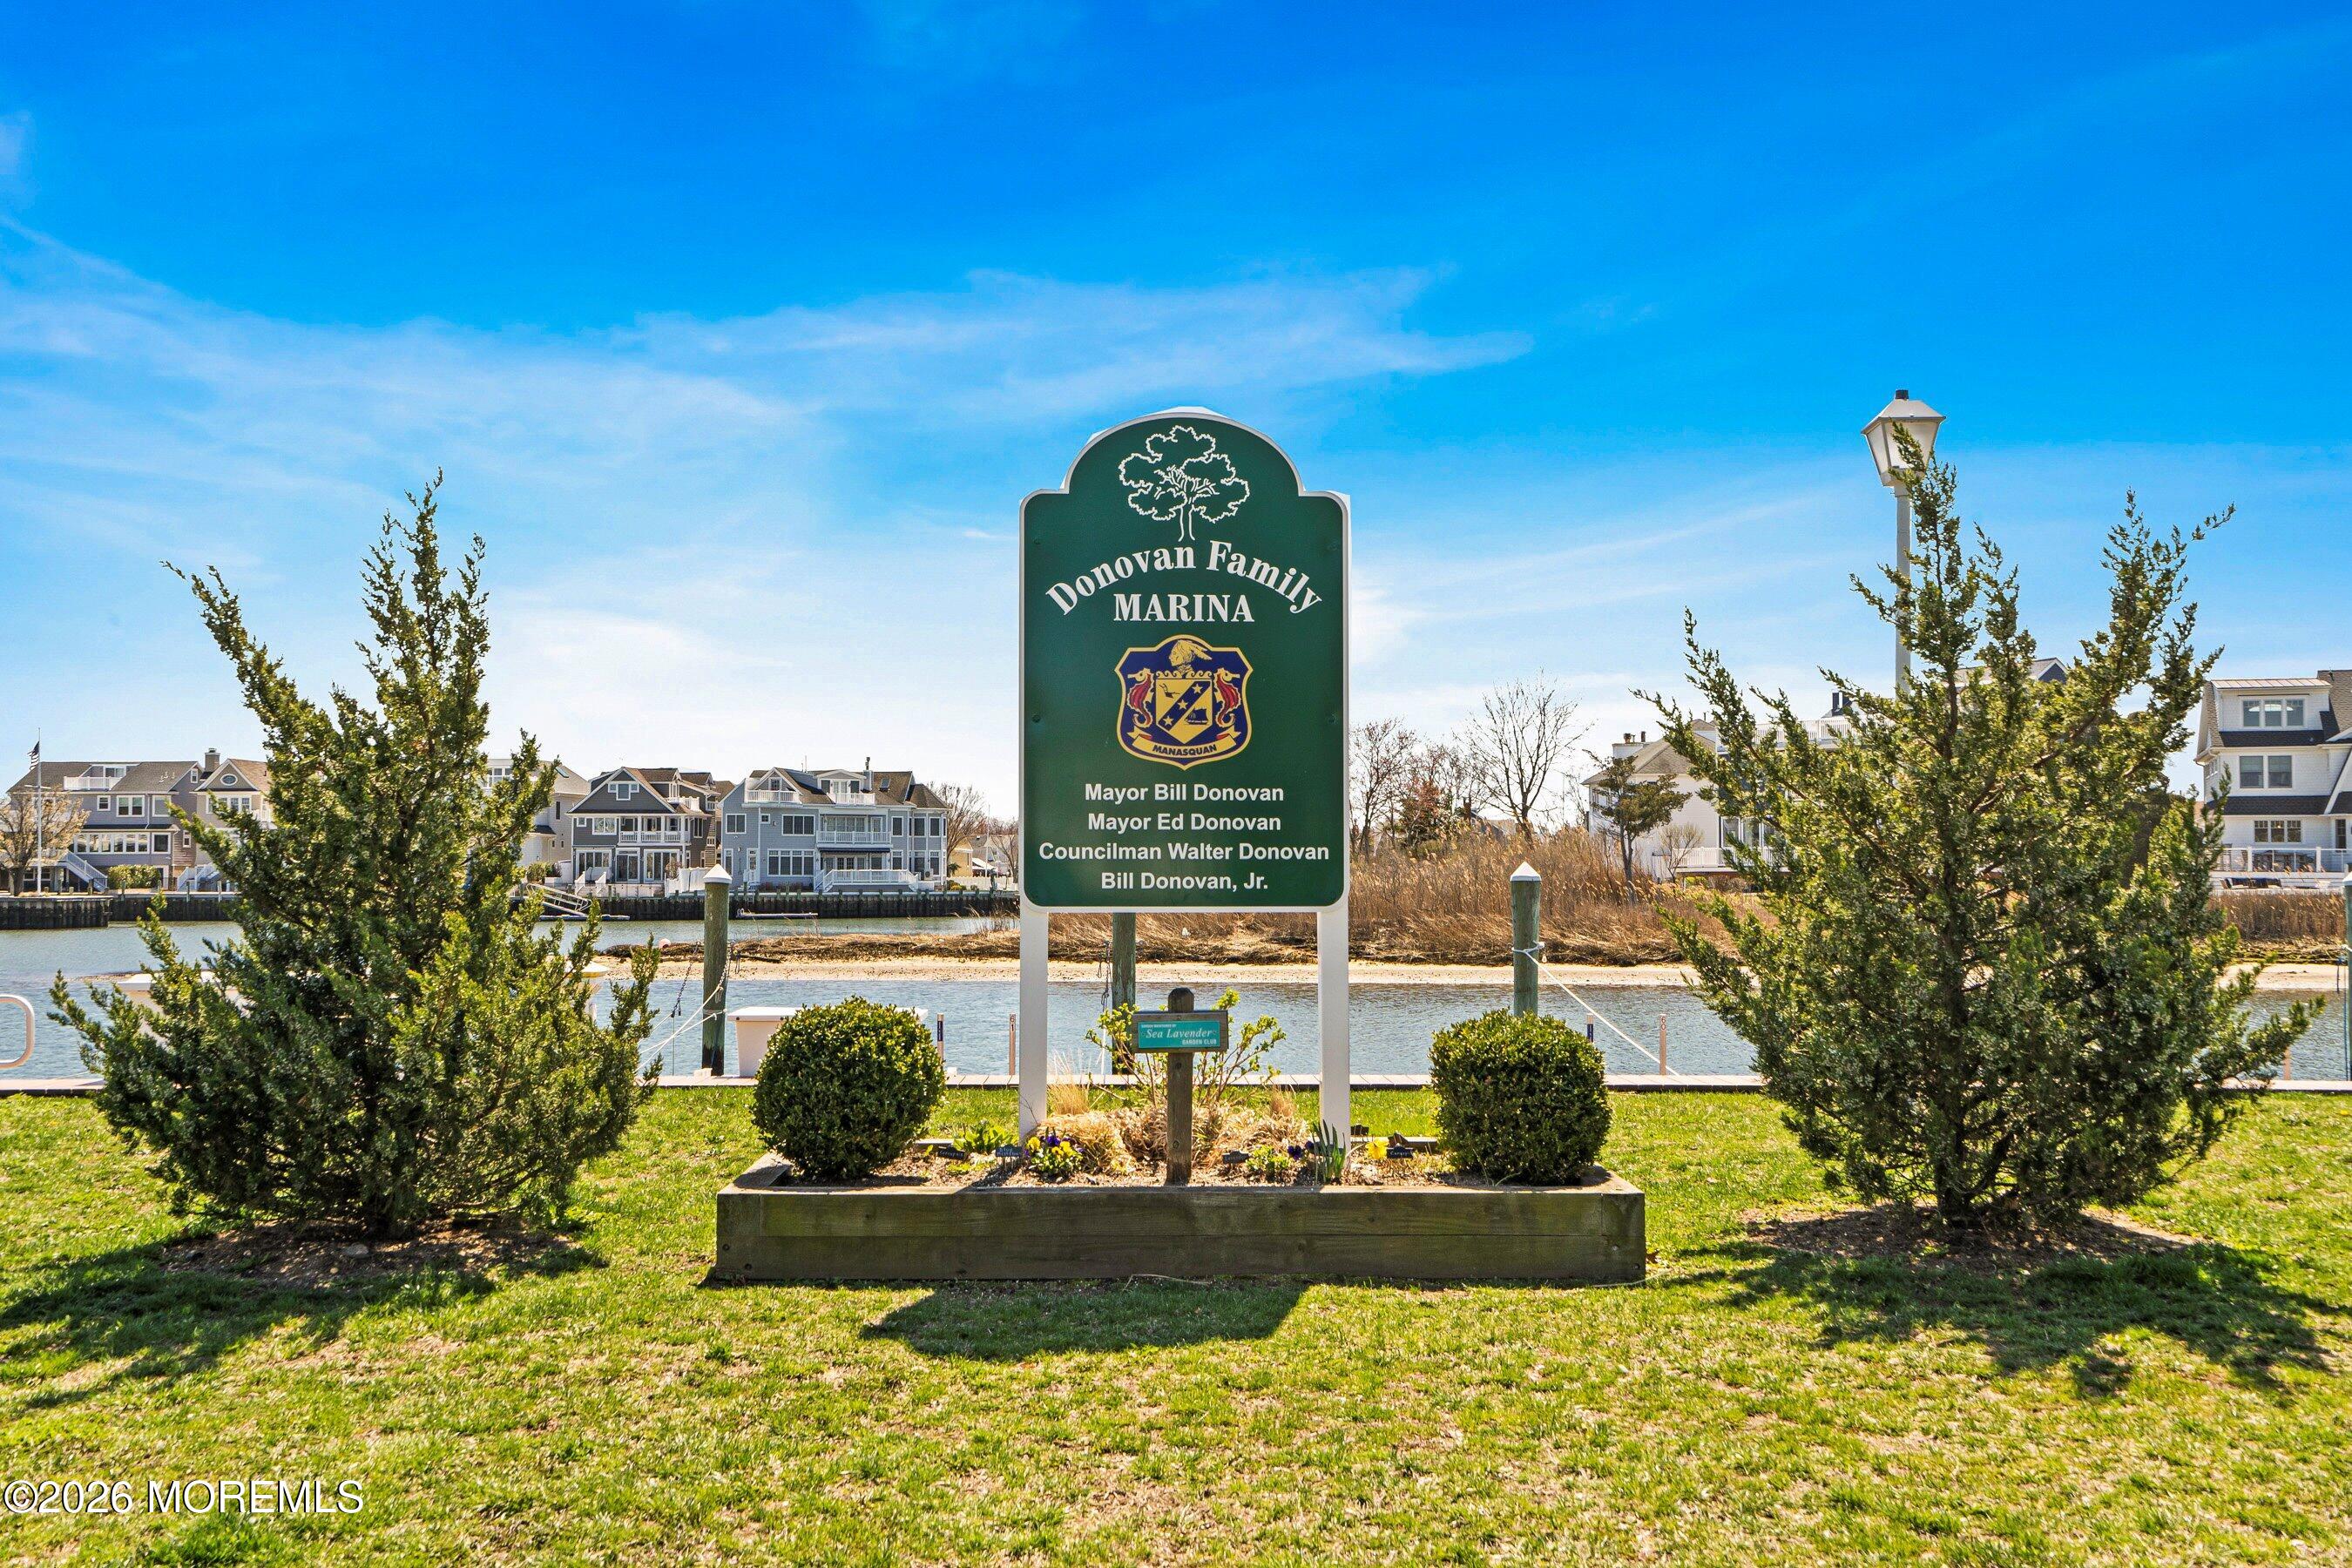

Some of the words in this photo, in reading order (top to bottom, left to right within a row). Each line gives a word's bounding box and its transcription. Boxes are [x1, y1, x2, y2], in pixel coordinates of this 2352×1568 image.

[1044, 546, 1196, 615] Donovan
[1206, 539, 1322, 614] Family
[1113, 593, 1254, 622] MARINA
[1152, 744, 1218, 756] MANASQUAN
[1085, 783, 1148, 805] Mayor
[1154, 783, 1187, 801] Bill
[1193, 783, 1284, 801] Donovan
[1088, 813, 1150, 835] Mayor
[1157, 813, 1184, 831] Ed
[1191, 813, 1281, 831] Donovan
[1038, 841, 1162, 861] Councilman
[1167, 842, 1233, 861] Walter
[1239, 842, 1329, 861] Donovan
[1101, 872, 1134, 889] Bill
[1140, 872, 1237, 893] Donovan,
[1243, 872, 1268, 889] Jr.
[1146, 1028, 1164, 1039] Sea
[1166, 1028, 1213, 1039] Lavender
